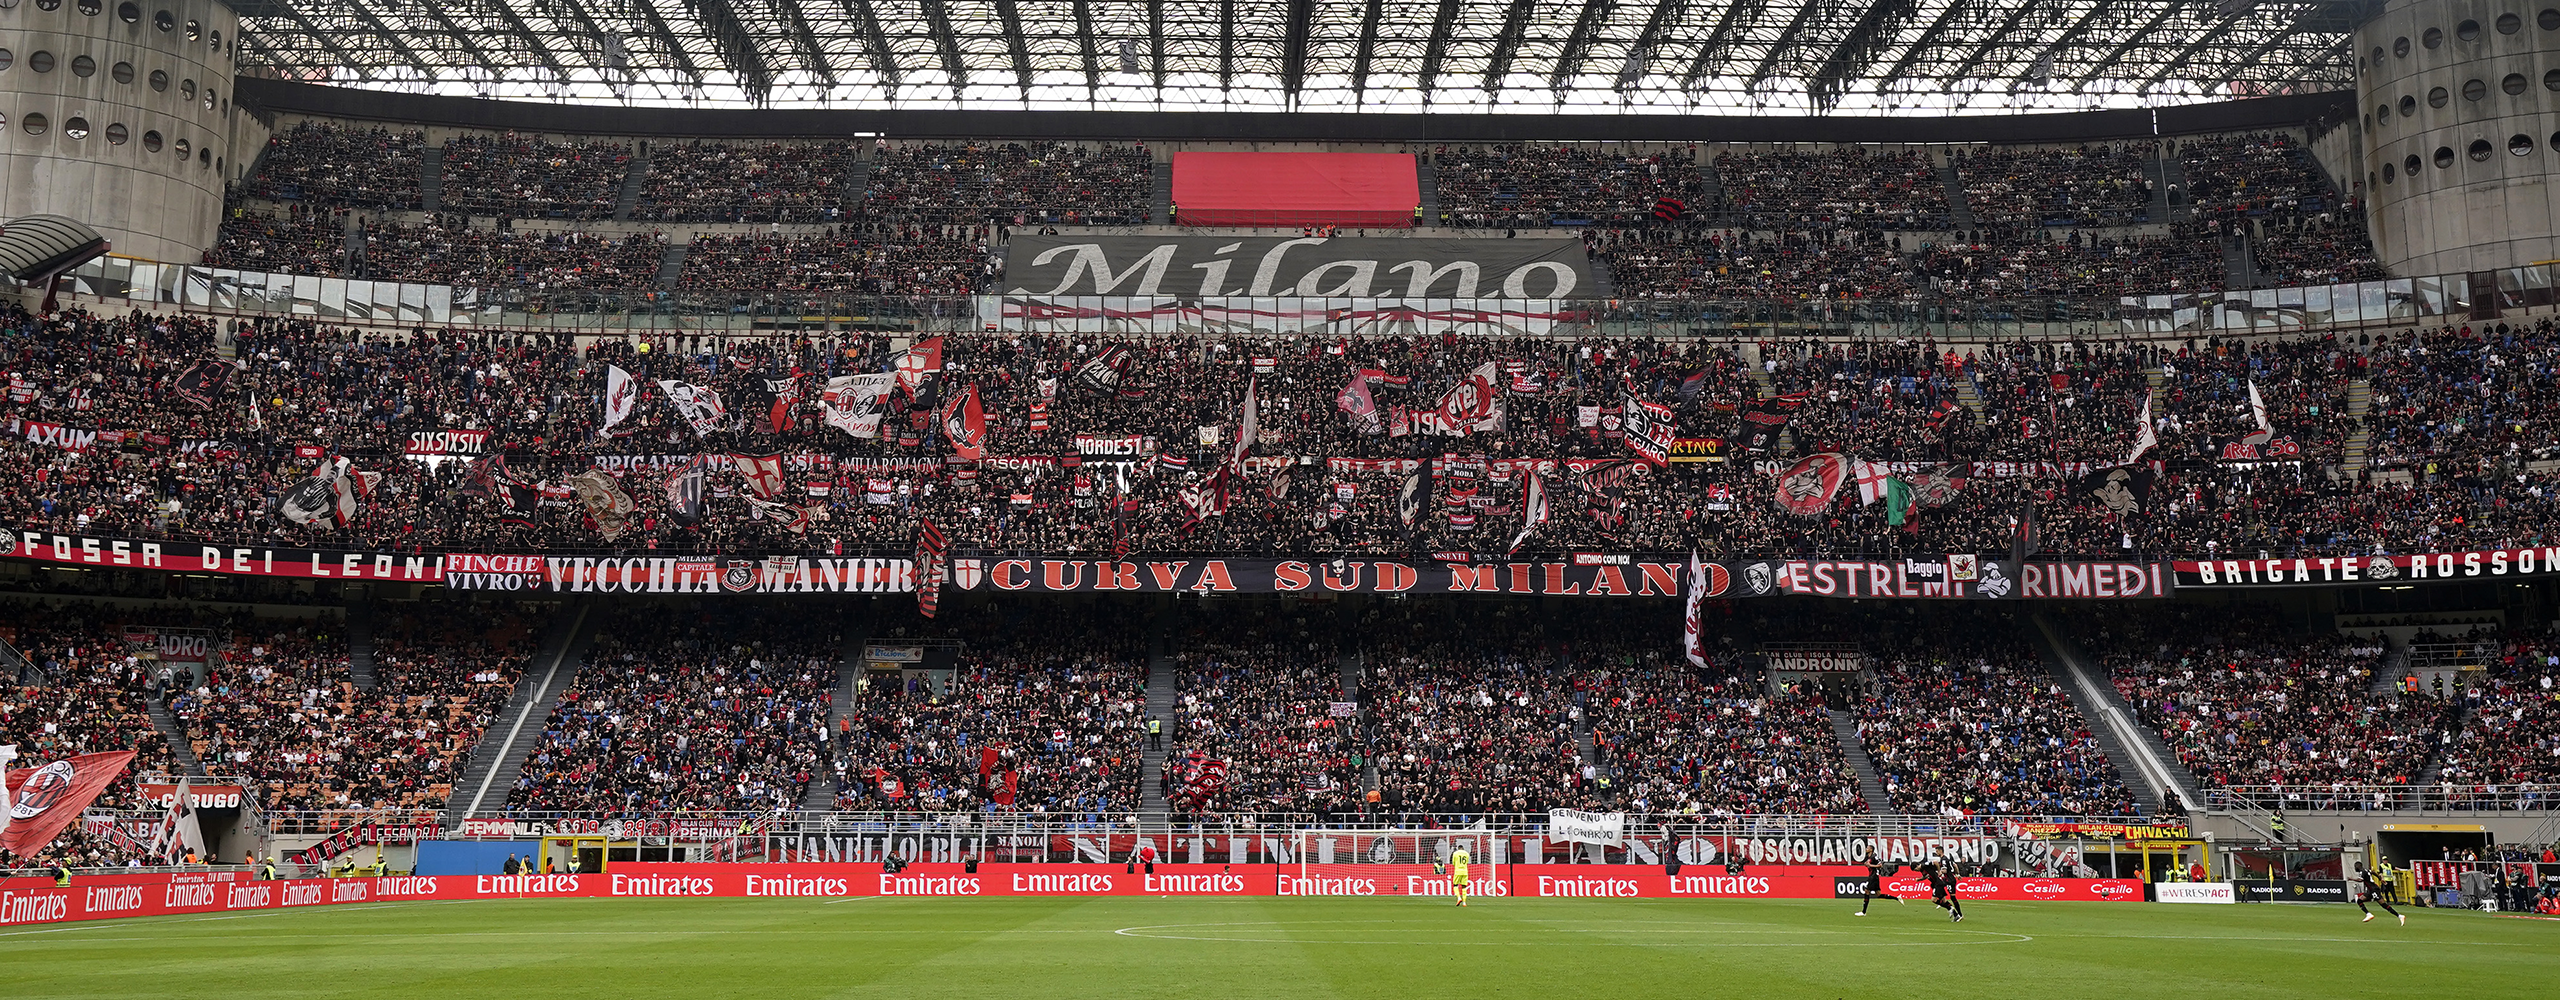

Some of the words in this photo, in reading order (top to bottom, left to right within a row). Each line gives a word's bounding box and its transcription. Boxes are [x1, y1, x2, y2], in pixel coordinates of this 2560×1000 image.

[1004, 236, 1578, 299] Milano
[27, 425, 96, 450] AXUM
[410, 431, 484, 454] SIXSIXSIX
[1076, 437, 1140, 455] NORDEST
[1672, 441, 1716, 454] RINO
[978, 457, 1053, 472] TOSCANA
[23, 531, 162, 567] FOSSA
[202, 546, 272, 573] DEI
[311, 552, 443, 580] LEONI
[1576, 553, 1602, 565] ANTONIO
[1603, 554, 1617, 564] CON
[2197, 556, 2360, 585] BRIGATE
[2410, 546, 2560, 579] ROSSON
[547, 556, 721, 595] VECCHIA
[756, 556, 914, 595] MANIER
[990, 560, 1238, 591] CURVA
[1274, 560, 1418, 591] SUD
[1447, 562, 1731, 596] MILANO
[1906, 557, 1943, 578] Baggio
[2021, 563, 2162, 598] RIMEDI
[1773, 658, 1863, 671] ANDRONNO
[1809, 651, 1832, 659] ISOLA
[161, 793, 240, 809] CRUGO
[1552, 809, 1618, 823] BENVENUTO
[361, 827, 445, 843] ALESSANDRIA
[464, 821, 542, 836] FEMMINILE
[1457, 854, 1467, 866] 16
[1734, 836, 1868, 866] TOSCOLANO
[281, 880, 322, 906] Emirates
[332, 878, 368, 902] Emirates
[376, 876, 437, 895] Emirates
[477, 875, 580, 894] Emirates
[611, 873, 714, 896] Emirates
[746, 873, 848, 896] Emirates
[879, 873, 981, 896] Emirates
[1012, 873, 1113, 892] Emirates
[1144, 874, 1245, 893] Emirates
[1277, 874, 1376, 896] Emirates
[1408, 874, 1507, 896] Emiates
[1538, 875, 1638, 897] Emirates
[1670, 875, 1770, 894] Emirates
[1888, 881, 1931, 892] Casillo
[1955, 882, 1998, 893] Casillo
[2022, 882, 2066, 893] Casillo
[2090, 883, 2133, 894] Casillo
[2161, 888, 2230, 898] #WERESPACT
[85, 884, 143, 912] Emirates
[165, 882, 215, 907] Emirates
[227, 880, 271, 908] Emirates
[0, 888, 68, 923] Emirates
